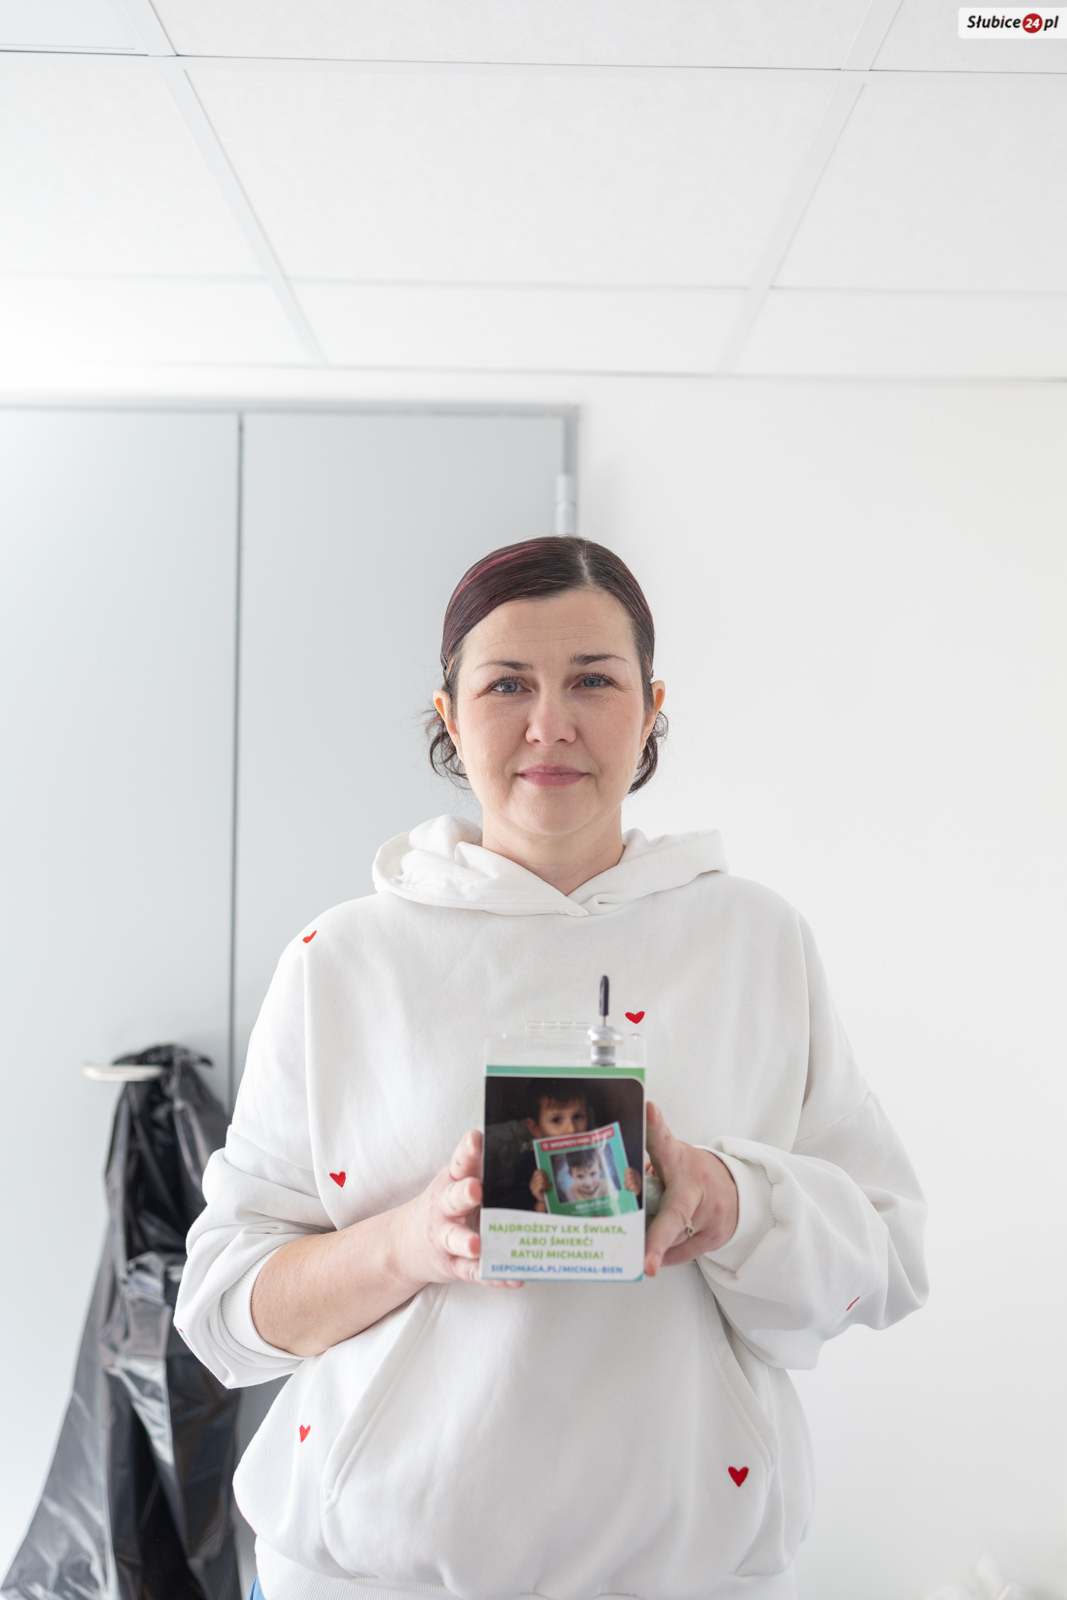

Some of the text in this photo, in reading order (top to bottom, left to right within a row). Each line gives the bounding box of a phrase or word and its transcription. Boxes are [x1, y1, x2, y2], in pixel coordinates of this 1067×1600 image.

[489, 1222, 627, 1235] NAJDROŻSZY LEK ŚWIATA,
[519, 1236, 593, 1247] ALBO ŚMIERĆ!
[511, 1250, 604, 1260] RATUJ MICHASIA!
